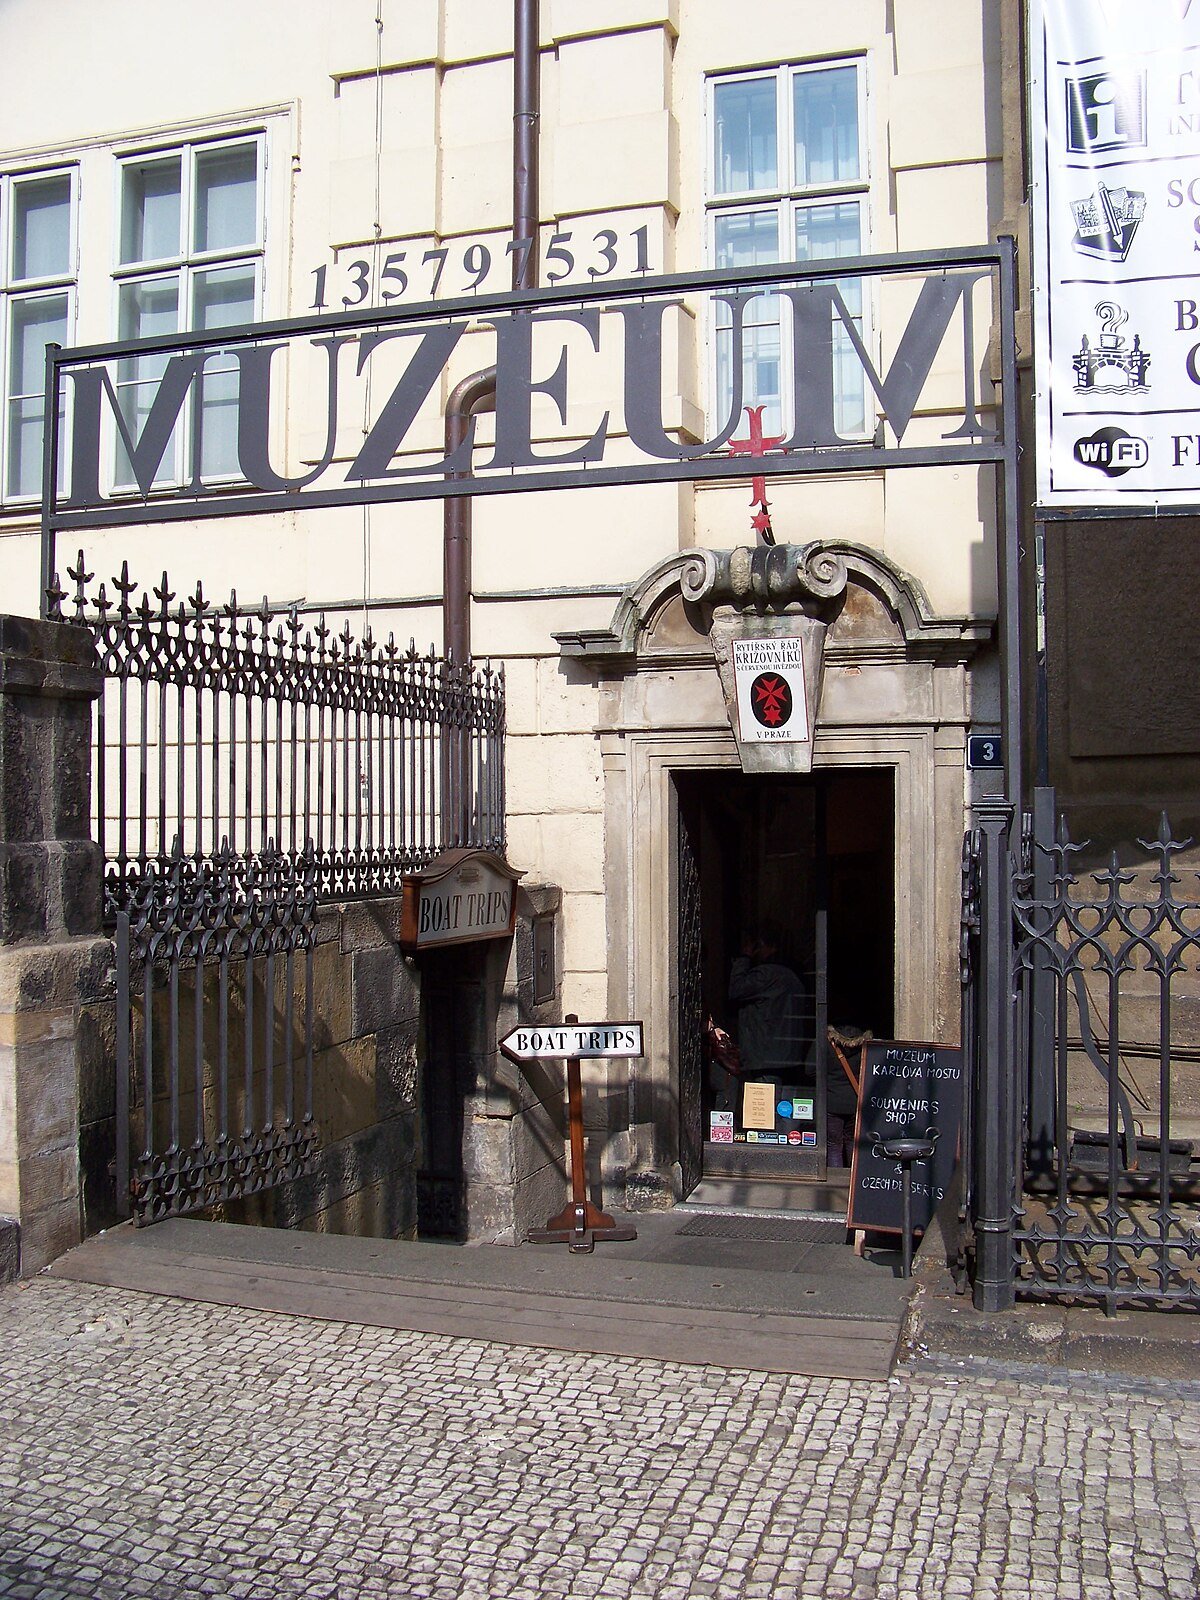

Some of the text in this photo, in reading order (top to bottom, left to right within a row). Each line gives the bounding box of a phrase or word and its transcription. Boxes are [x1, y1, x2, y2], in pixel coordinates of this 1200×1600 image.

[309, 224, 655, 310] 135797531
[62, 268, 999, 510] MUZEUM
[780, 640, 798, 650] ŘÁD
[764, 730, 792, 738] PRAZE
[982, 742, 995, 761] 3
[419, 890, 509, 933] BOAT TRIPS
[516, 1030, 635, 1051] BOAT TRIPS
[886, 1049, 936, 1064] MUZEUM
[873, 1064, 960, 1080] KARLOVA MOSTU
[870, 1096, 940, 1115] SOUVENIRS
[885, 1111, 917, 1124] SHOP
[862, 1177, 944, 1200] CZECH DESERTS
